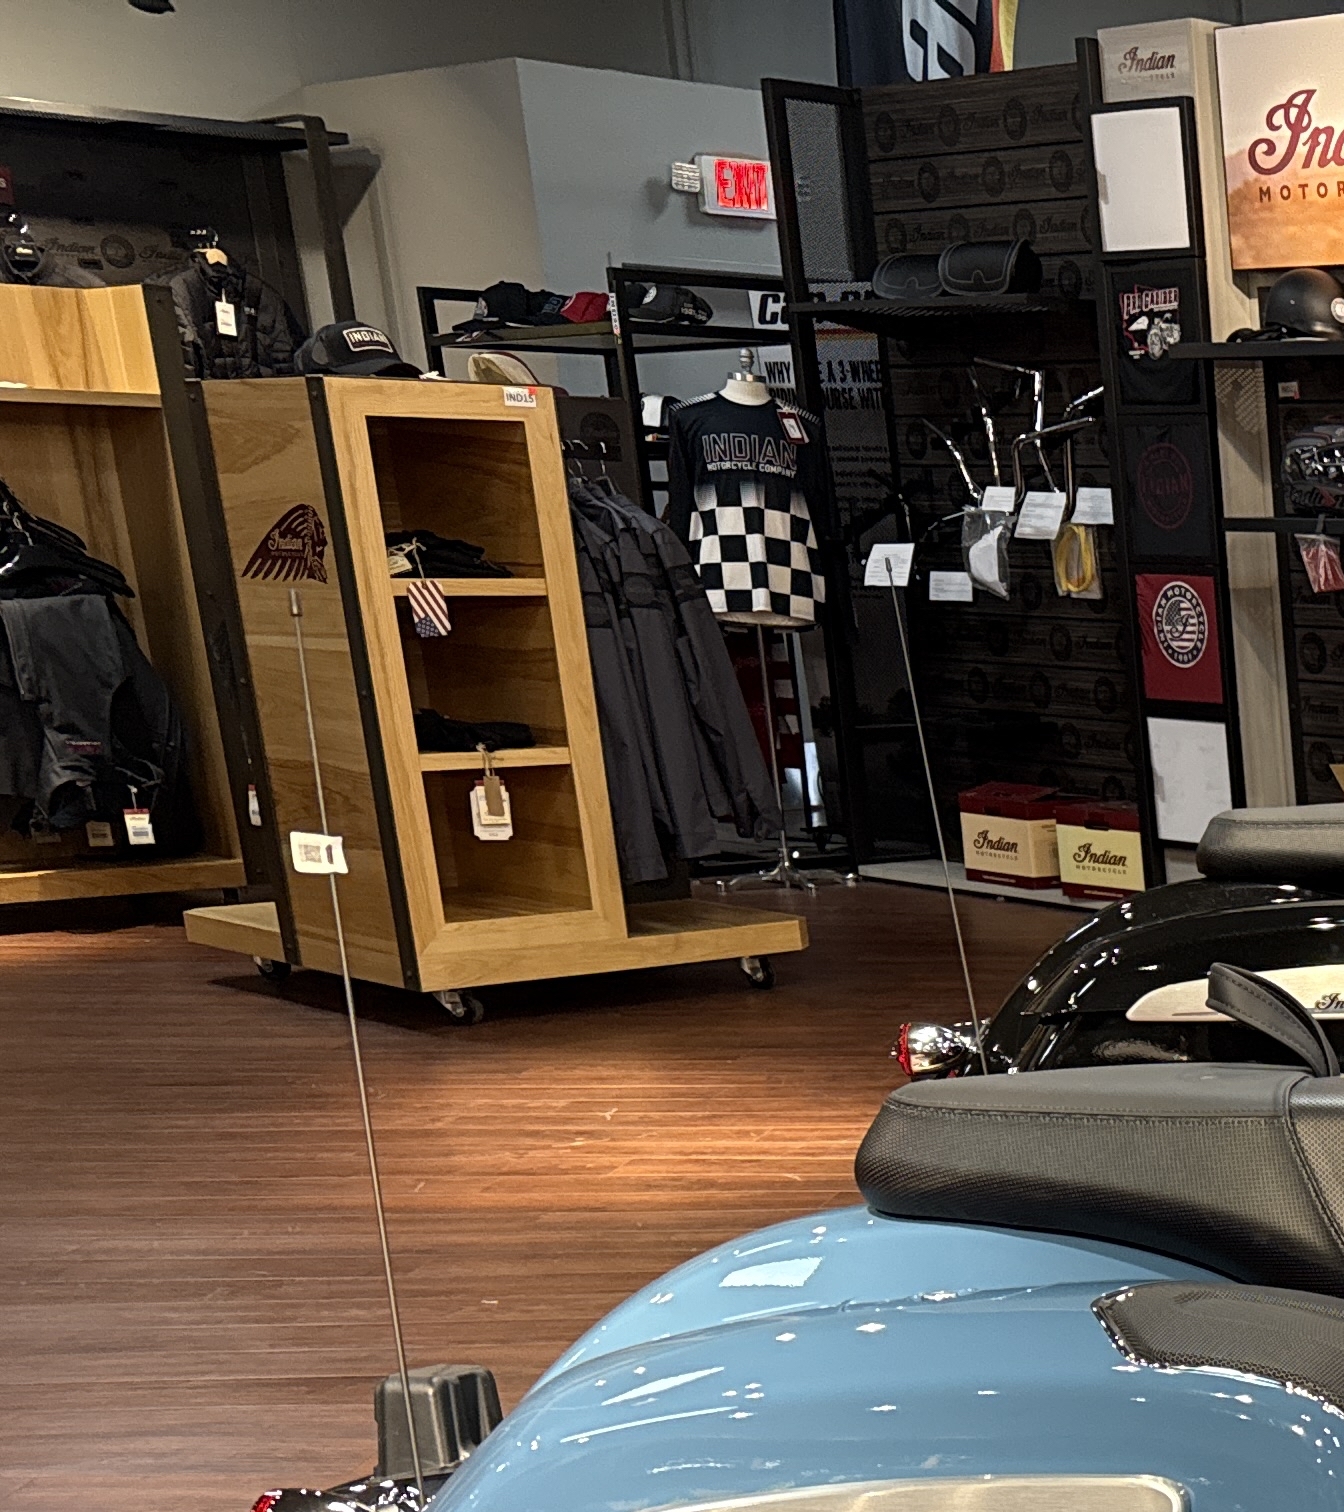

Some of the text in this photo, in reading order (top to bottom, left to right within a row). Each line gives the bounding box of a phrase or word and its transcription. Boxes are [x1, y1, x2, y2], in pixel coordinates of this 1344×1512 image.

[1118, 46, 1176, 75] Indian
[347, 330, 387, 344] INDIAN
[764, 361, 791, 384] WHY
[701, 432, 798, 471] INDIAN
[706, 461, 797, 479] MOTORCYCLE COMPANY
[973, 829, 1019, 855] Indian
[1073, 842, 1129, 868] Indian
